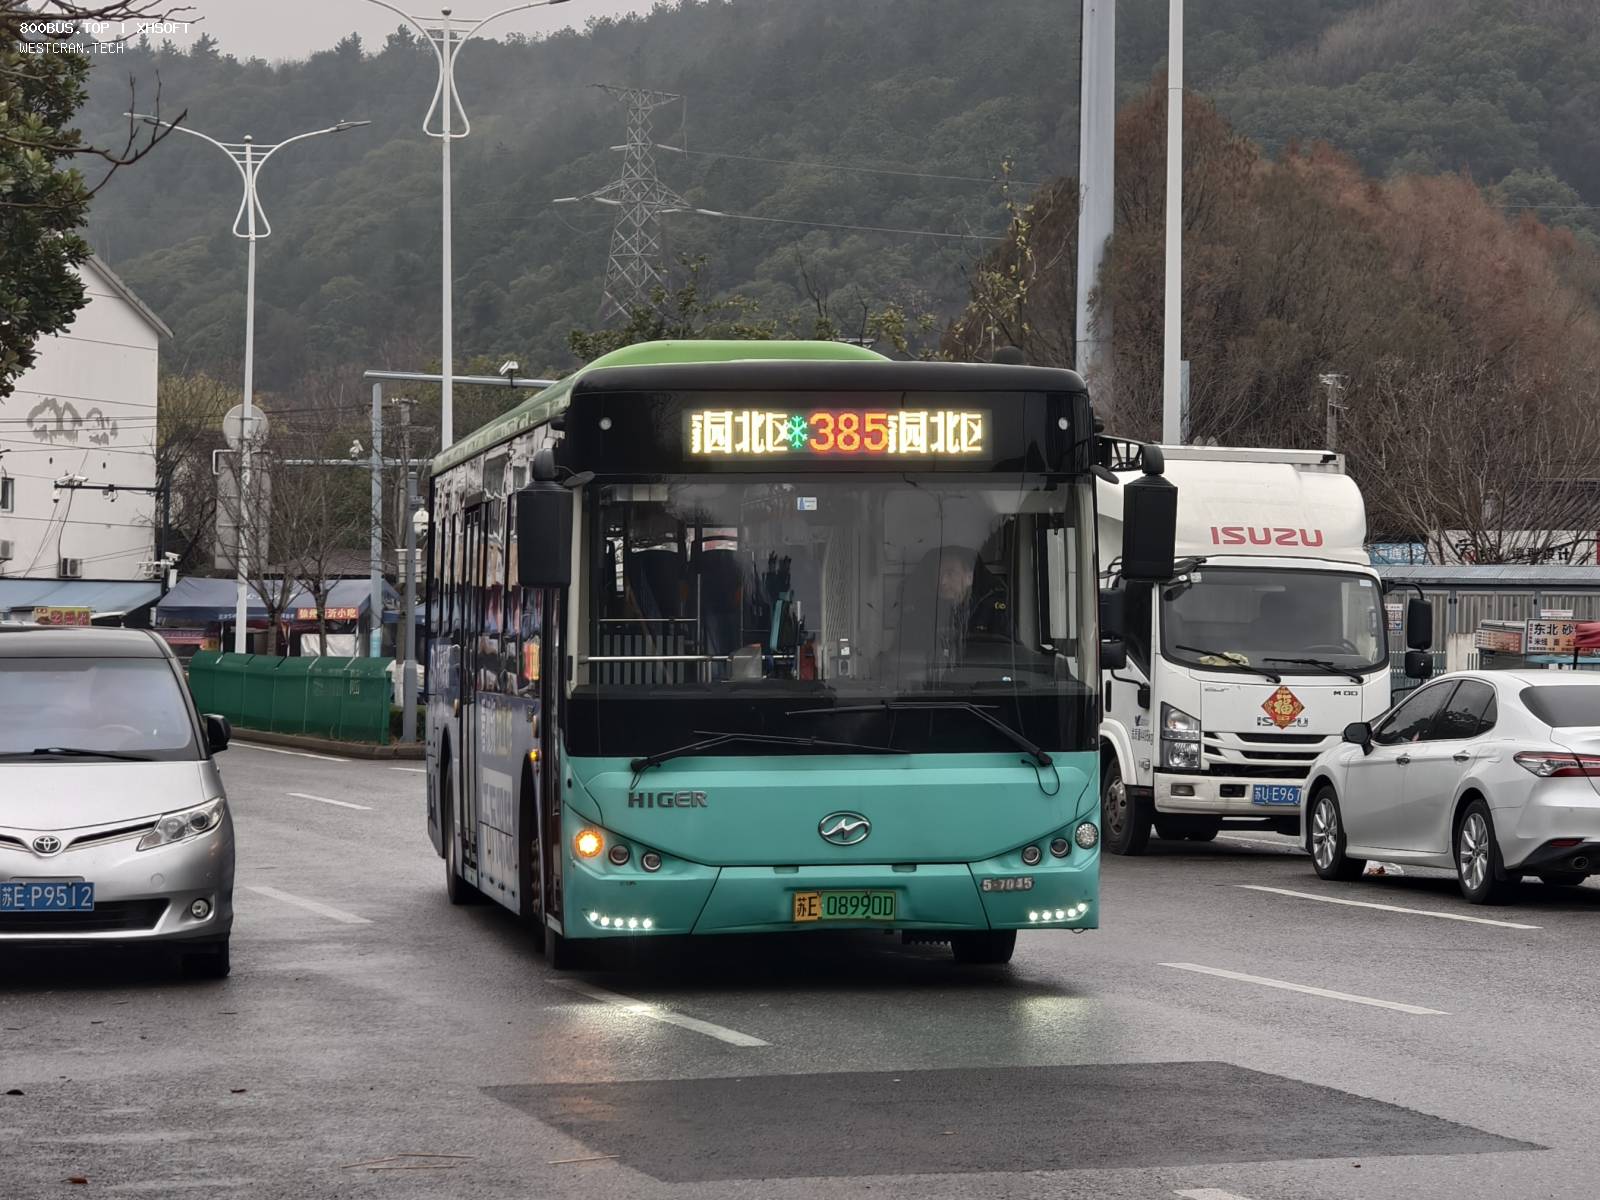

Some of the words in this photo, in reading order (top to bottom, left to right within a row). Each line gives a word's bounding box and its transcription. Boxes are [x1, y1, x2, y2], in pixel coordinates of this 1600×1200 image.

[809, 412, 888, 451] 385
[1210, 526, 1323, 547] ISUZU
[1533, 623, 1576, 636] 东北砂
[1274, 694, 1294, 715] 福
[1256, 716, 1309, 728] ISU
[628, 791, 708, 808] HIGER
